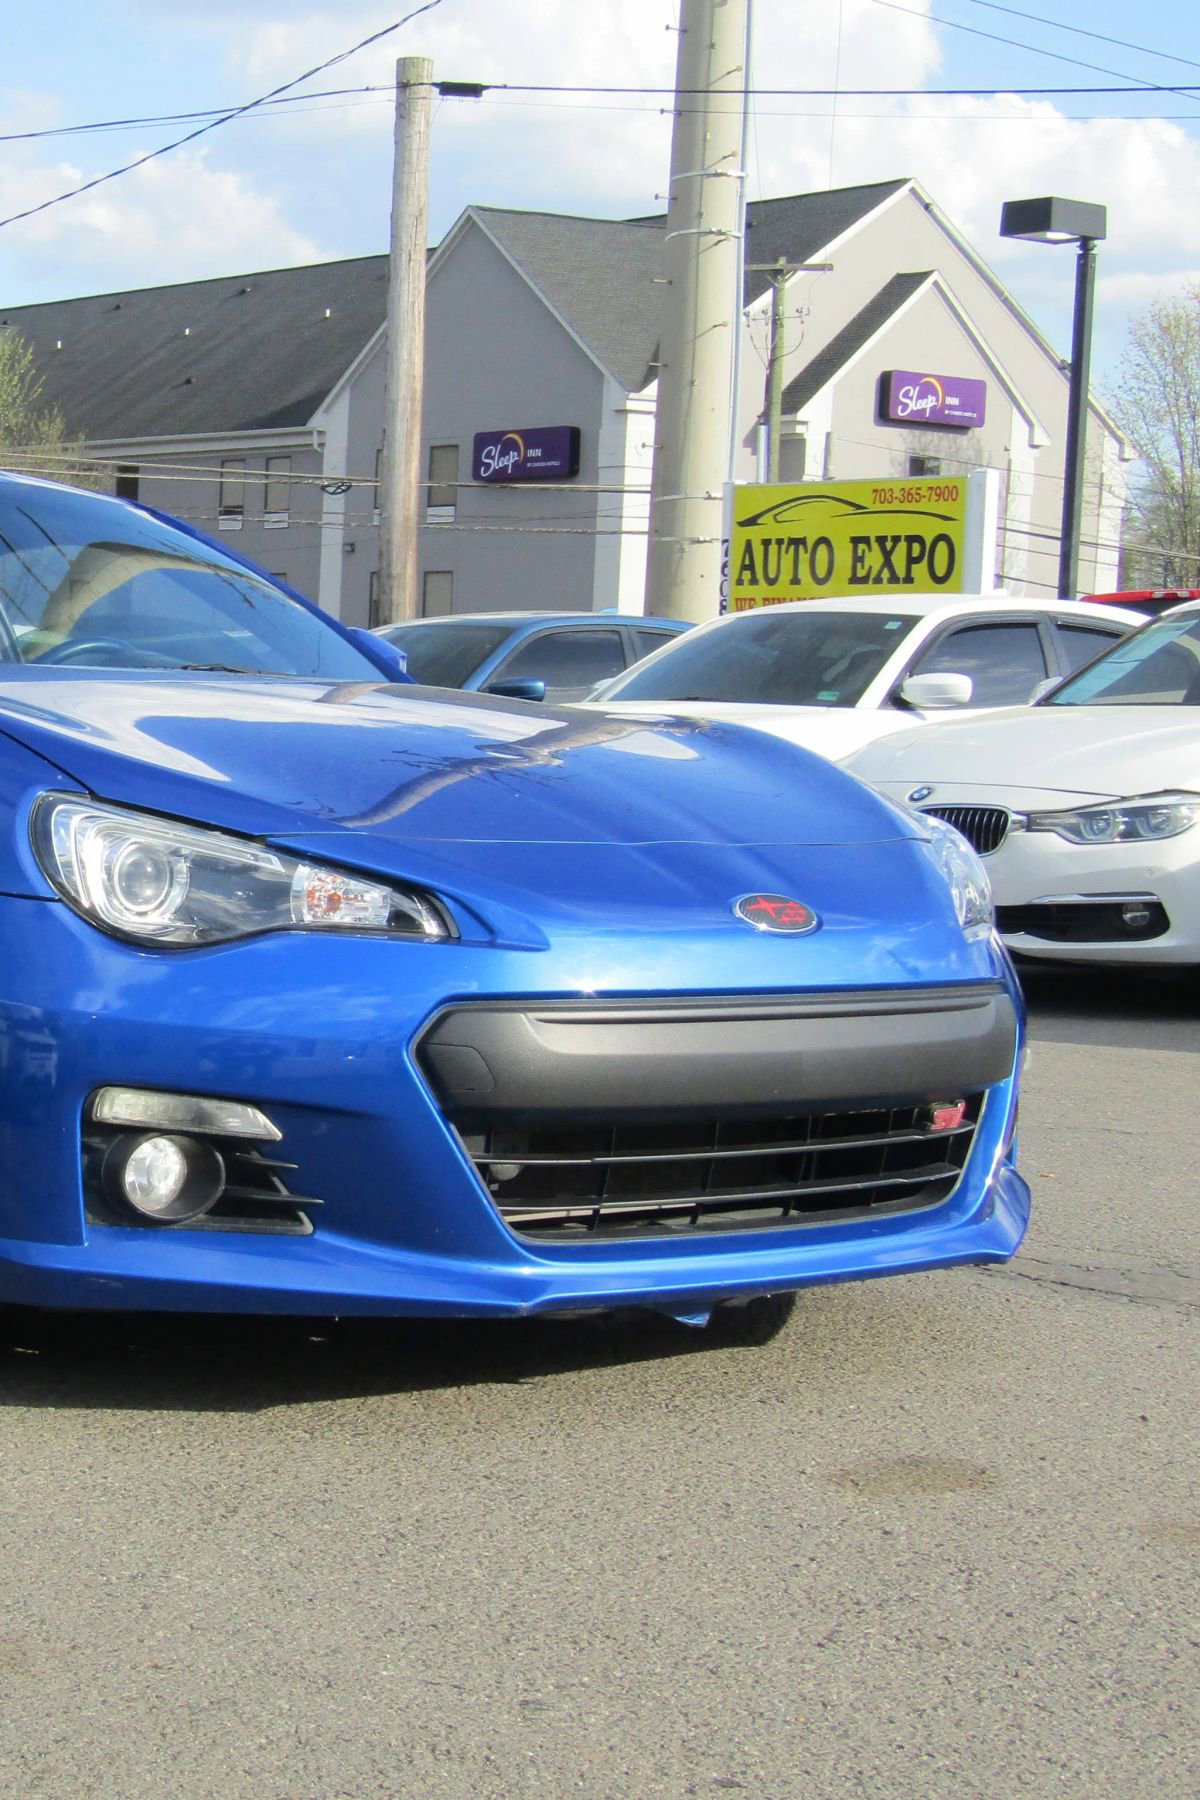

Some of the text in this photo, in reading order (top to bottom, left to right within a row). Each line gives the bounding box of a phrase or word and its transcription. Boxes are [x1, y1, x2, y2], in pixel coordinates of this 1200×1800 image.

[897, 385, 938, 418] Sleep
[480, 444, 542, 477] Sleep INN
[871, 485, 959, 505] 703-365-7900
[735, 533, 956, 587] AUTO EXPO
